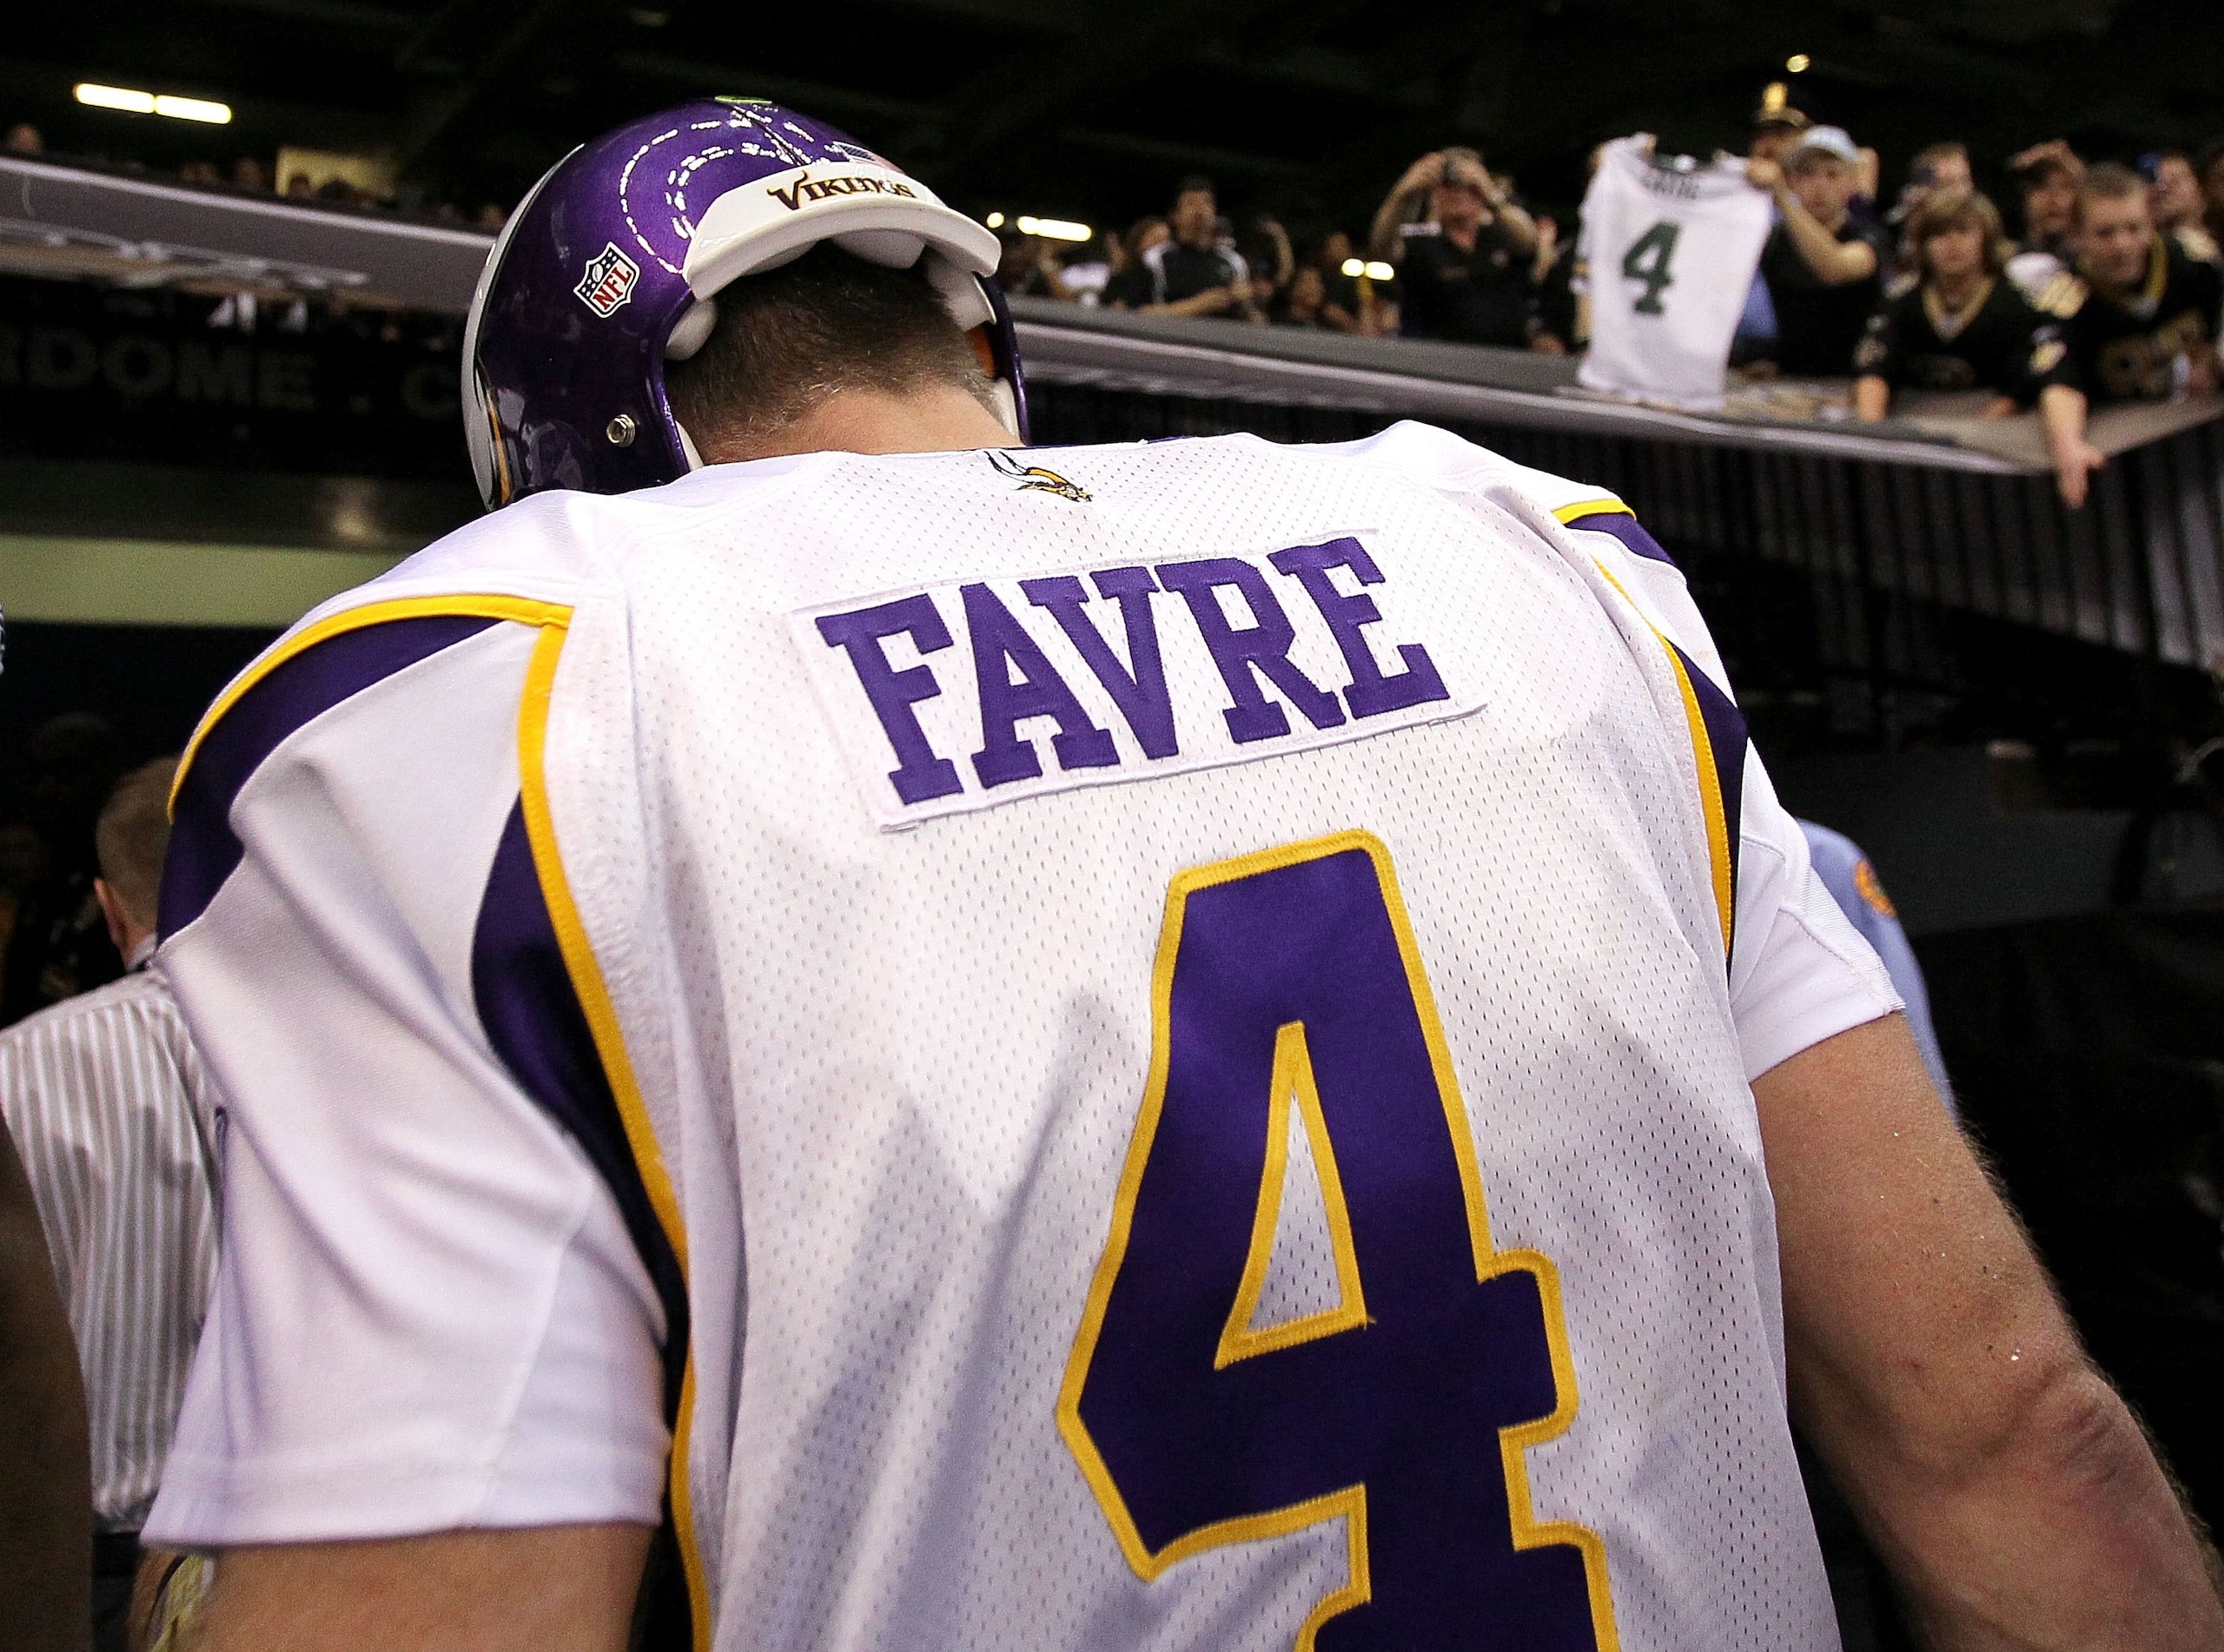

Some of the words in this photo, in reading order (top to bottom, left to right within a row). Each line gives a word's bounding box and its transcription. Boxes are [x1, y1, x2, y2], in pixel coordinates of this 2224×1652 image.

[592, 266, 632, 310] NFL
[1622, 221, 1681, 316] 4
[815, 536, 1451, 805] FAVRE
[1056, 828, 1620, 1652] 4
